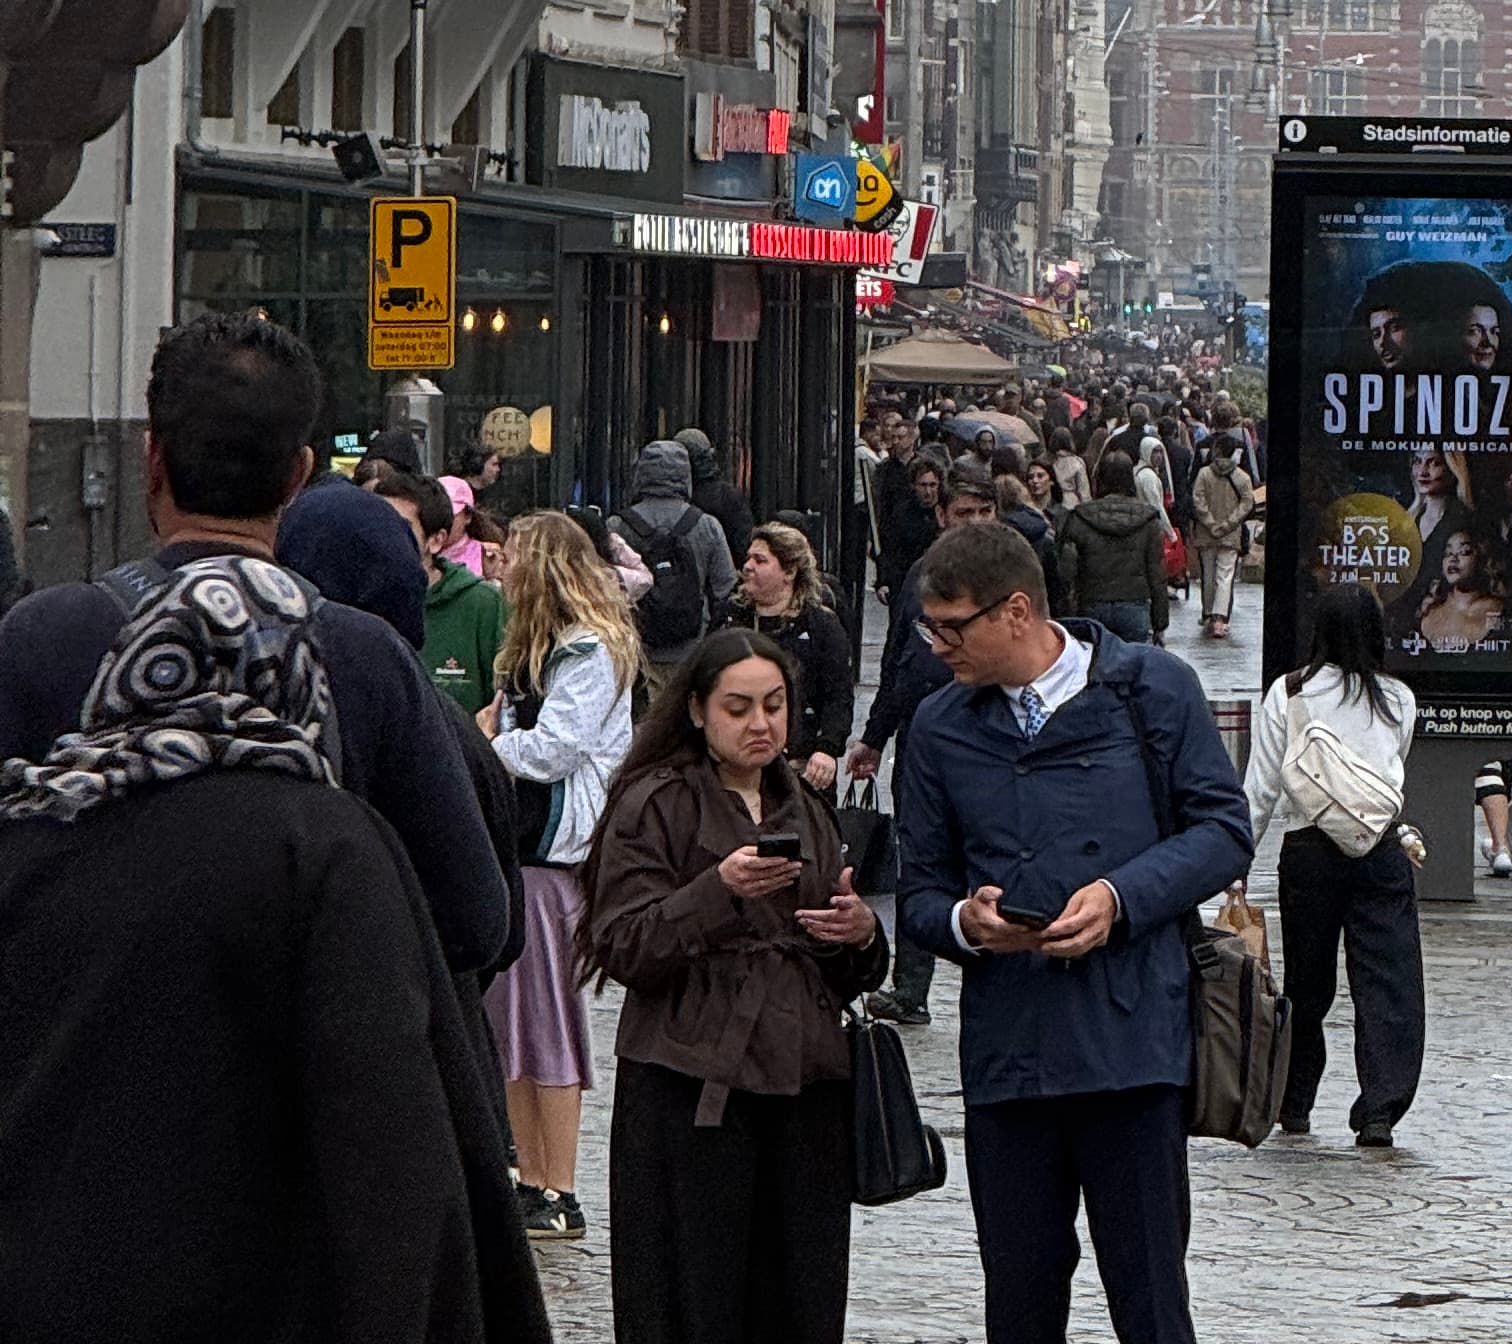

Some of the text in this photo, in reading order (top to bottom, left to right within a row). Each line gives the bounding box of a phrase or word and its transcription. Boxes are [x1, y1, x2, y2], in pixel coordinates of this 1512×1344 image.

[1363, 124, 1511, 143] Stadsinformatie
[392, 209, 432, 268] P
[1342, 440, 1364, 450] DE
[1371, 440, 1435, 451] MOKUM
[1318, 545, 1411, 567] THEATER
[1329, 571, 1337, 583] 2
[1340, 570, 1359, 583] JUN
[1382, 571, 1400, 584] JUL
[1417, 707, 1437, 718] ruk
[1440, 709, 1457, 721] op
[1460, 707, 1493, 721] knop
[1425, 721, 1458, 733] Push
[1460, 722, 1503, 734] button
